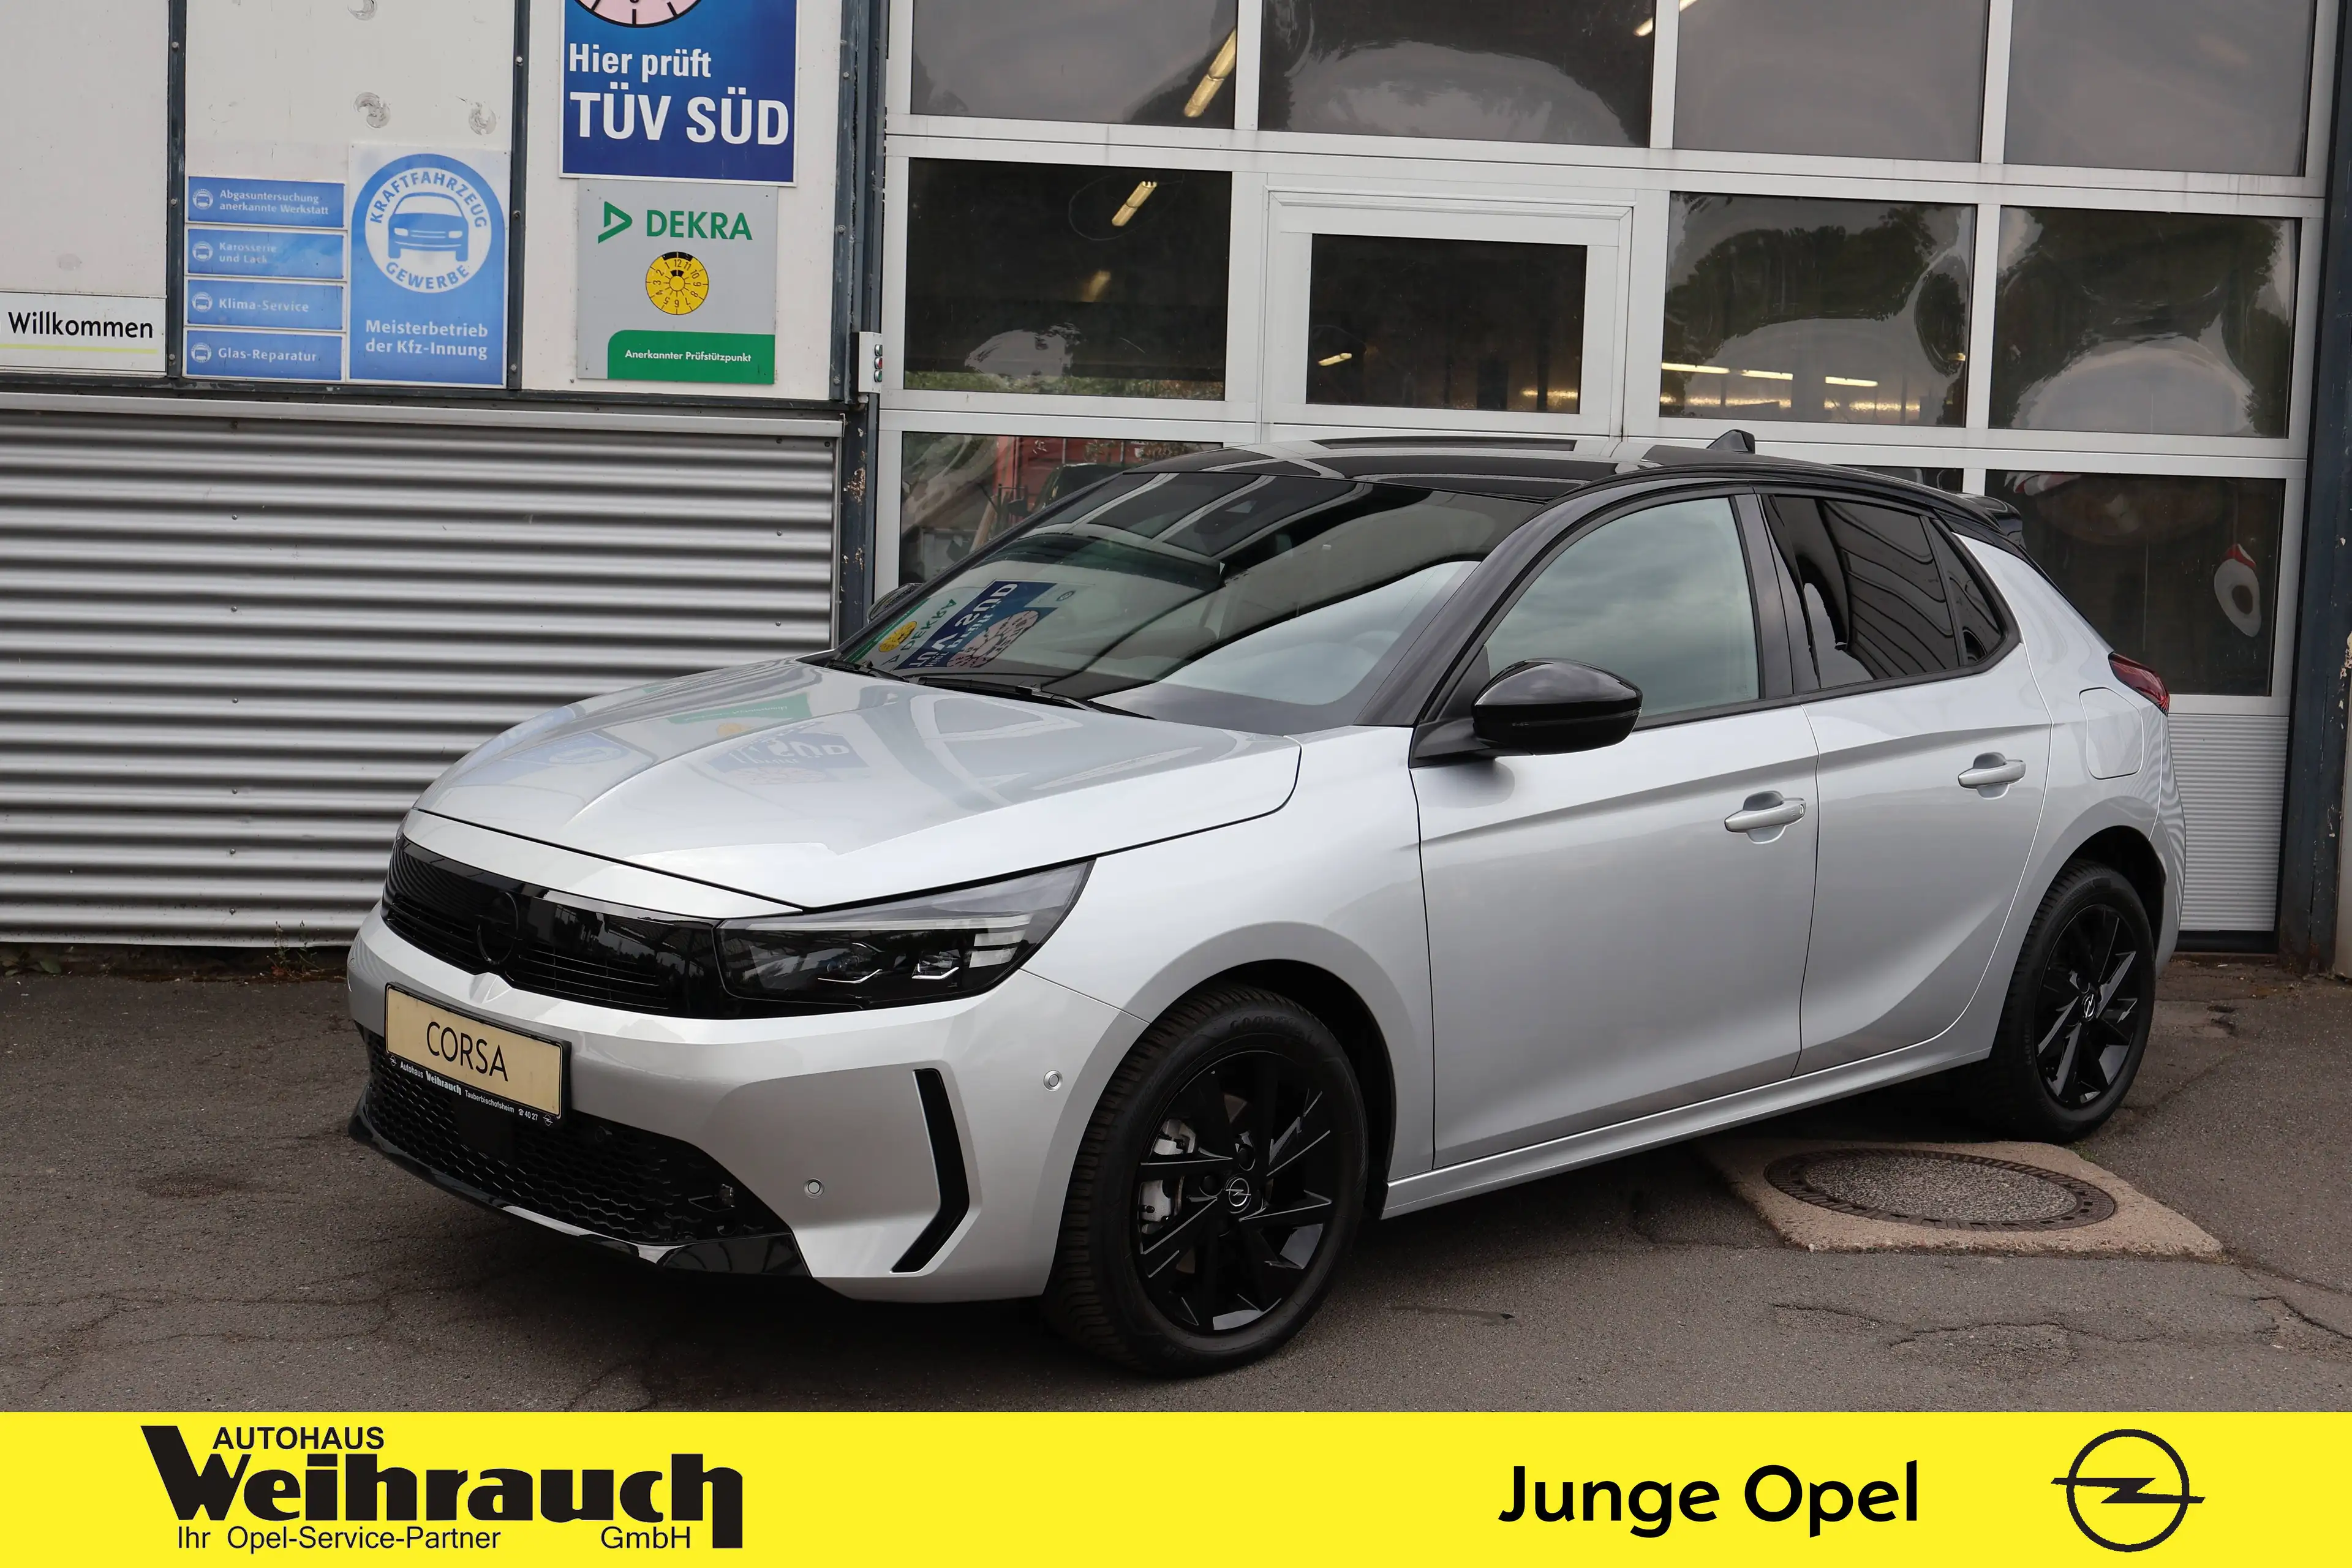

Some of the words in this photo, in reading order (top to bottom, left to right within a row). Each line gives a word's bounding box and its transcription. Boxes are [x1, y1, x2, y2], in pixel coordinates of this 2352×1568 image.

[570, 43, 633, 74] Hier
[642, 48, 712, 83] prüft
[570, 81, 671, 140] TÜV
[687, 86, 789, 145] SÜD
[219, 189, 319, 204] Abgasuntersuchung
[370, 171, 487, 228] KRAFTFAHRZEUG
[219, 202, 277, 213] anerkannte
[280, 204, 329, 215] Werkstatt
[646, 209, 753, 241] DEKRA
[219, 242, 277, 252] Karosserie
[244, 254, 268, 264] Lack
[674, 259, 682, 268] 12
[684, 262, 692, 271] 11
[386, 262, 469, 289] GEWERBE
[690, 270, 700, 279] 10
[219, 298, 309, 312] Klima-Service
[8, 311, 153, 338] Willkommen
[366, 319, 488, 337] Meisterbetrieb
[218, 348, 317, 363] Glas-Reparatur
[366, 338, 393, 353] der
[398, 339, 488, 361] Kfz-Innung
[625, 349, 683, 360] Anerkannter
[685, 352, 752, 363] Prüfstützpunkt
[426, 1021, 508, 1082] CORSA
[400, 1061, 424, 1078] Autohaus
[425, 1070, 462, 1096] Weihrauch
[465, 1090, 514, 1113] Tauberbischofsheim
[524, 1110, 531, 1119] 40
